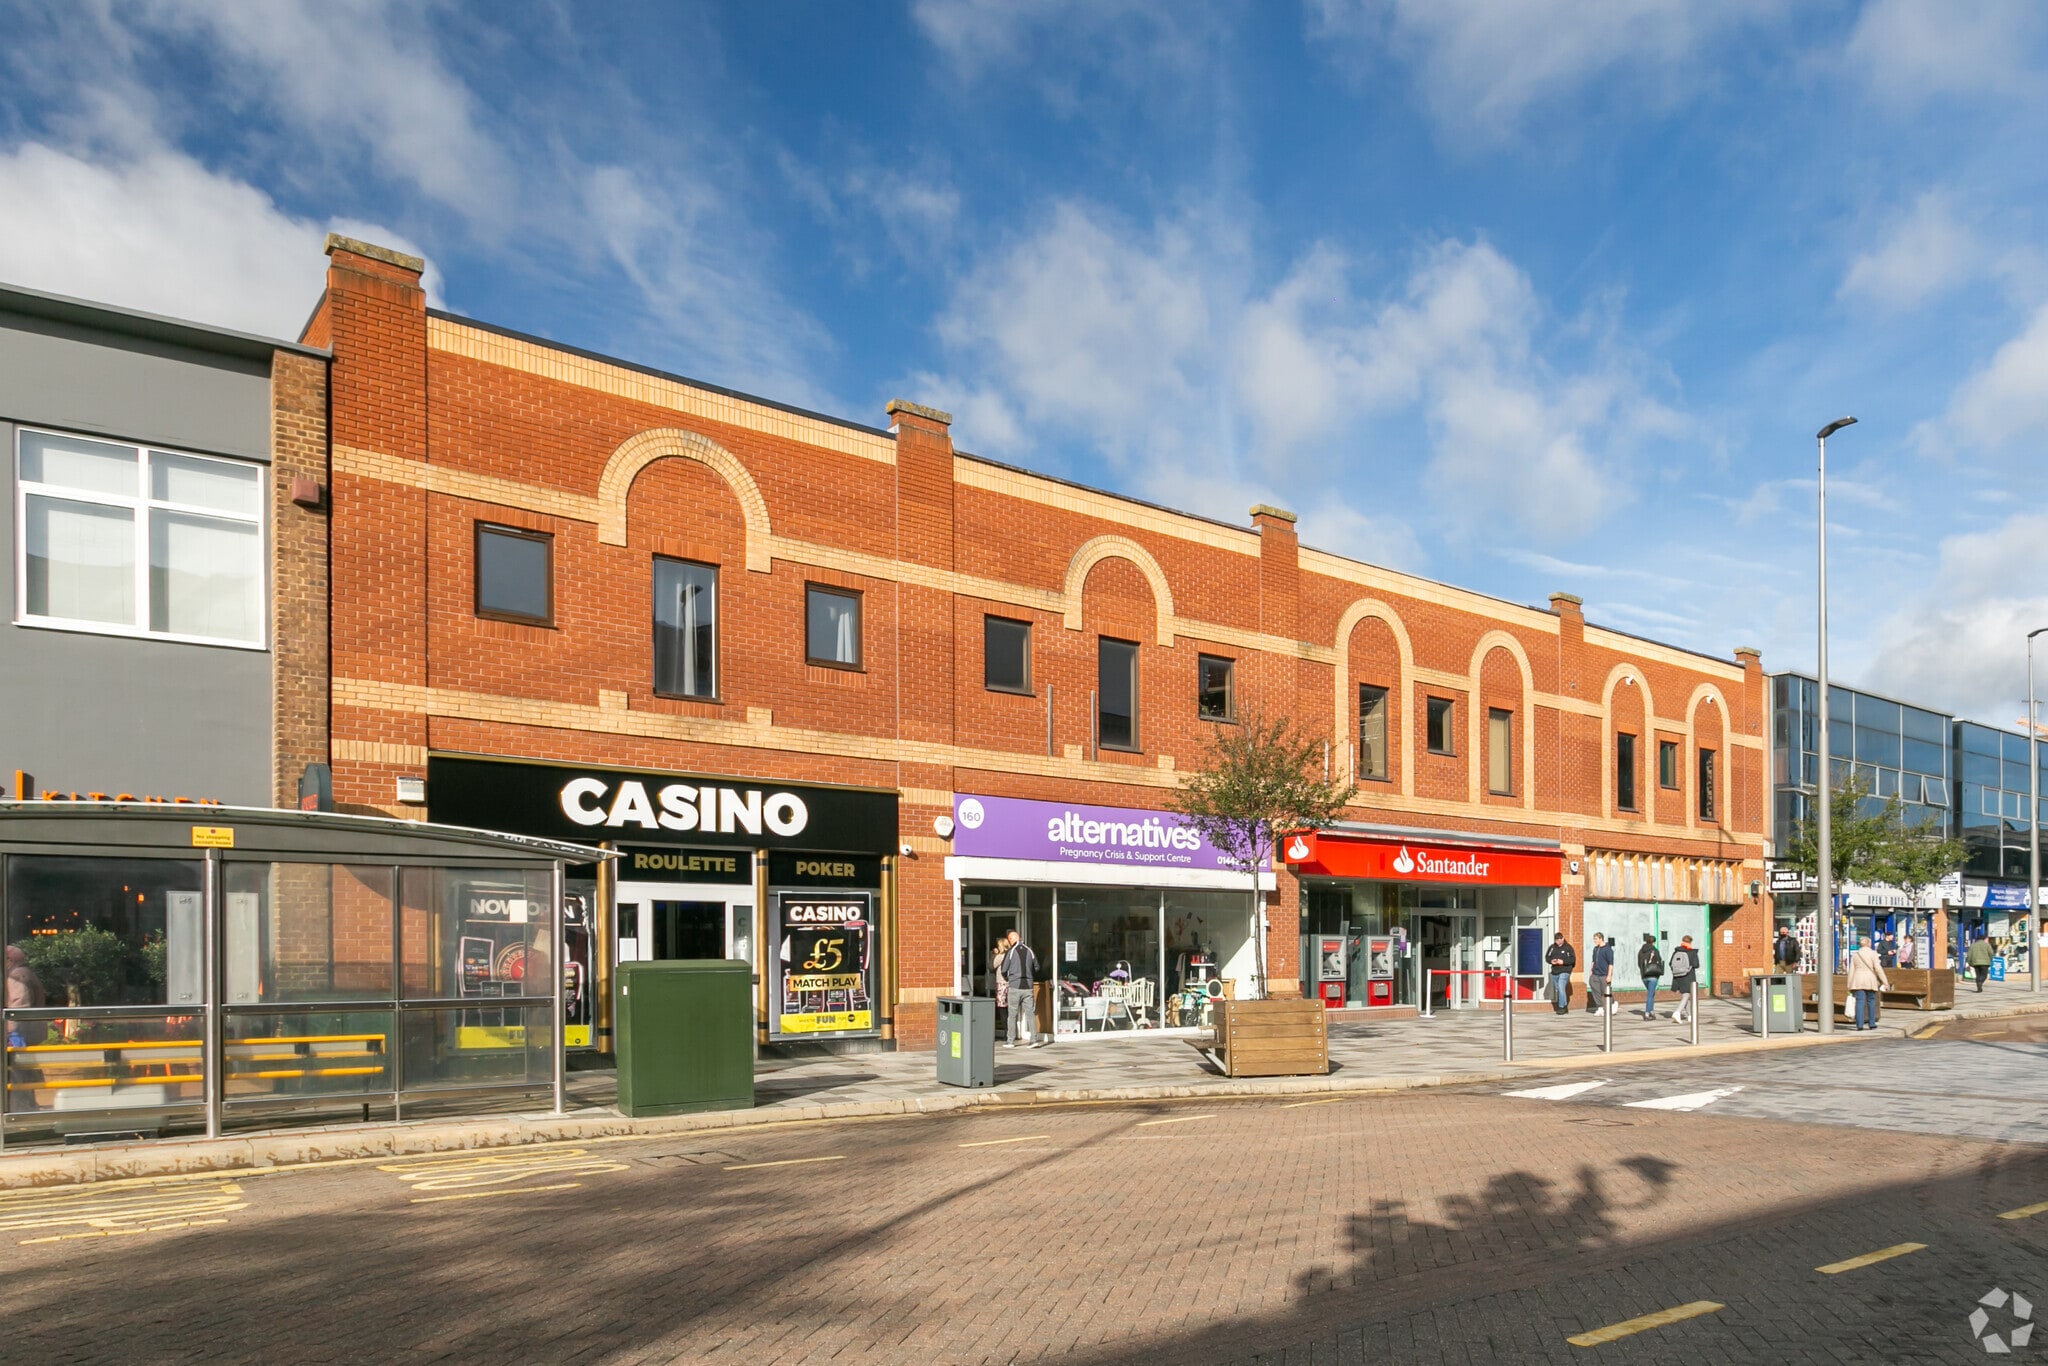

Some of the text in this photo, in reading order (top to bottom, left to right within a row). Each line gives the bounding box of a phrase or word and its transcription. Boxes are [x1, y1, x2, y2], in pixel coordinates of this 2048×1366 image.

[560, 777, 809, 837] CASINO
[963, 811, 981, 821] 160
[1048, 811, 1201, 850] alternatives
[634, 853, 736, 873] ROULETTE
[1060, 847, 1192, 863] Pregnancy Crisis & Support Centre
[796, 861, 856, 877] POKER
[1417, 851, 1490, 877] Santander
[1868, 895, 1882, 905] OPEN
[790, 905, 861, 922] CASINO
[802, 938, 845, 971] £5
[793, 977, 857, 988] MATCH PLAY
[816, 1015, 836, 1024] FUN
